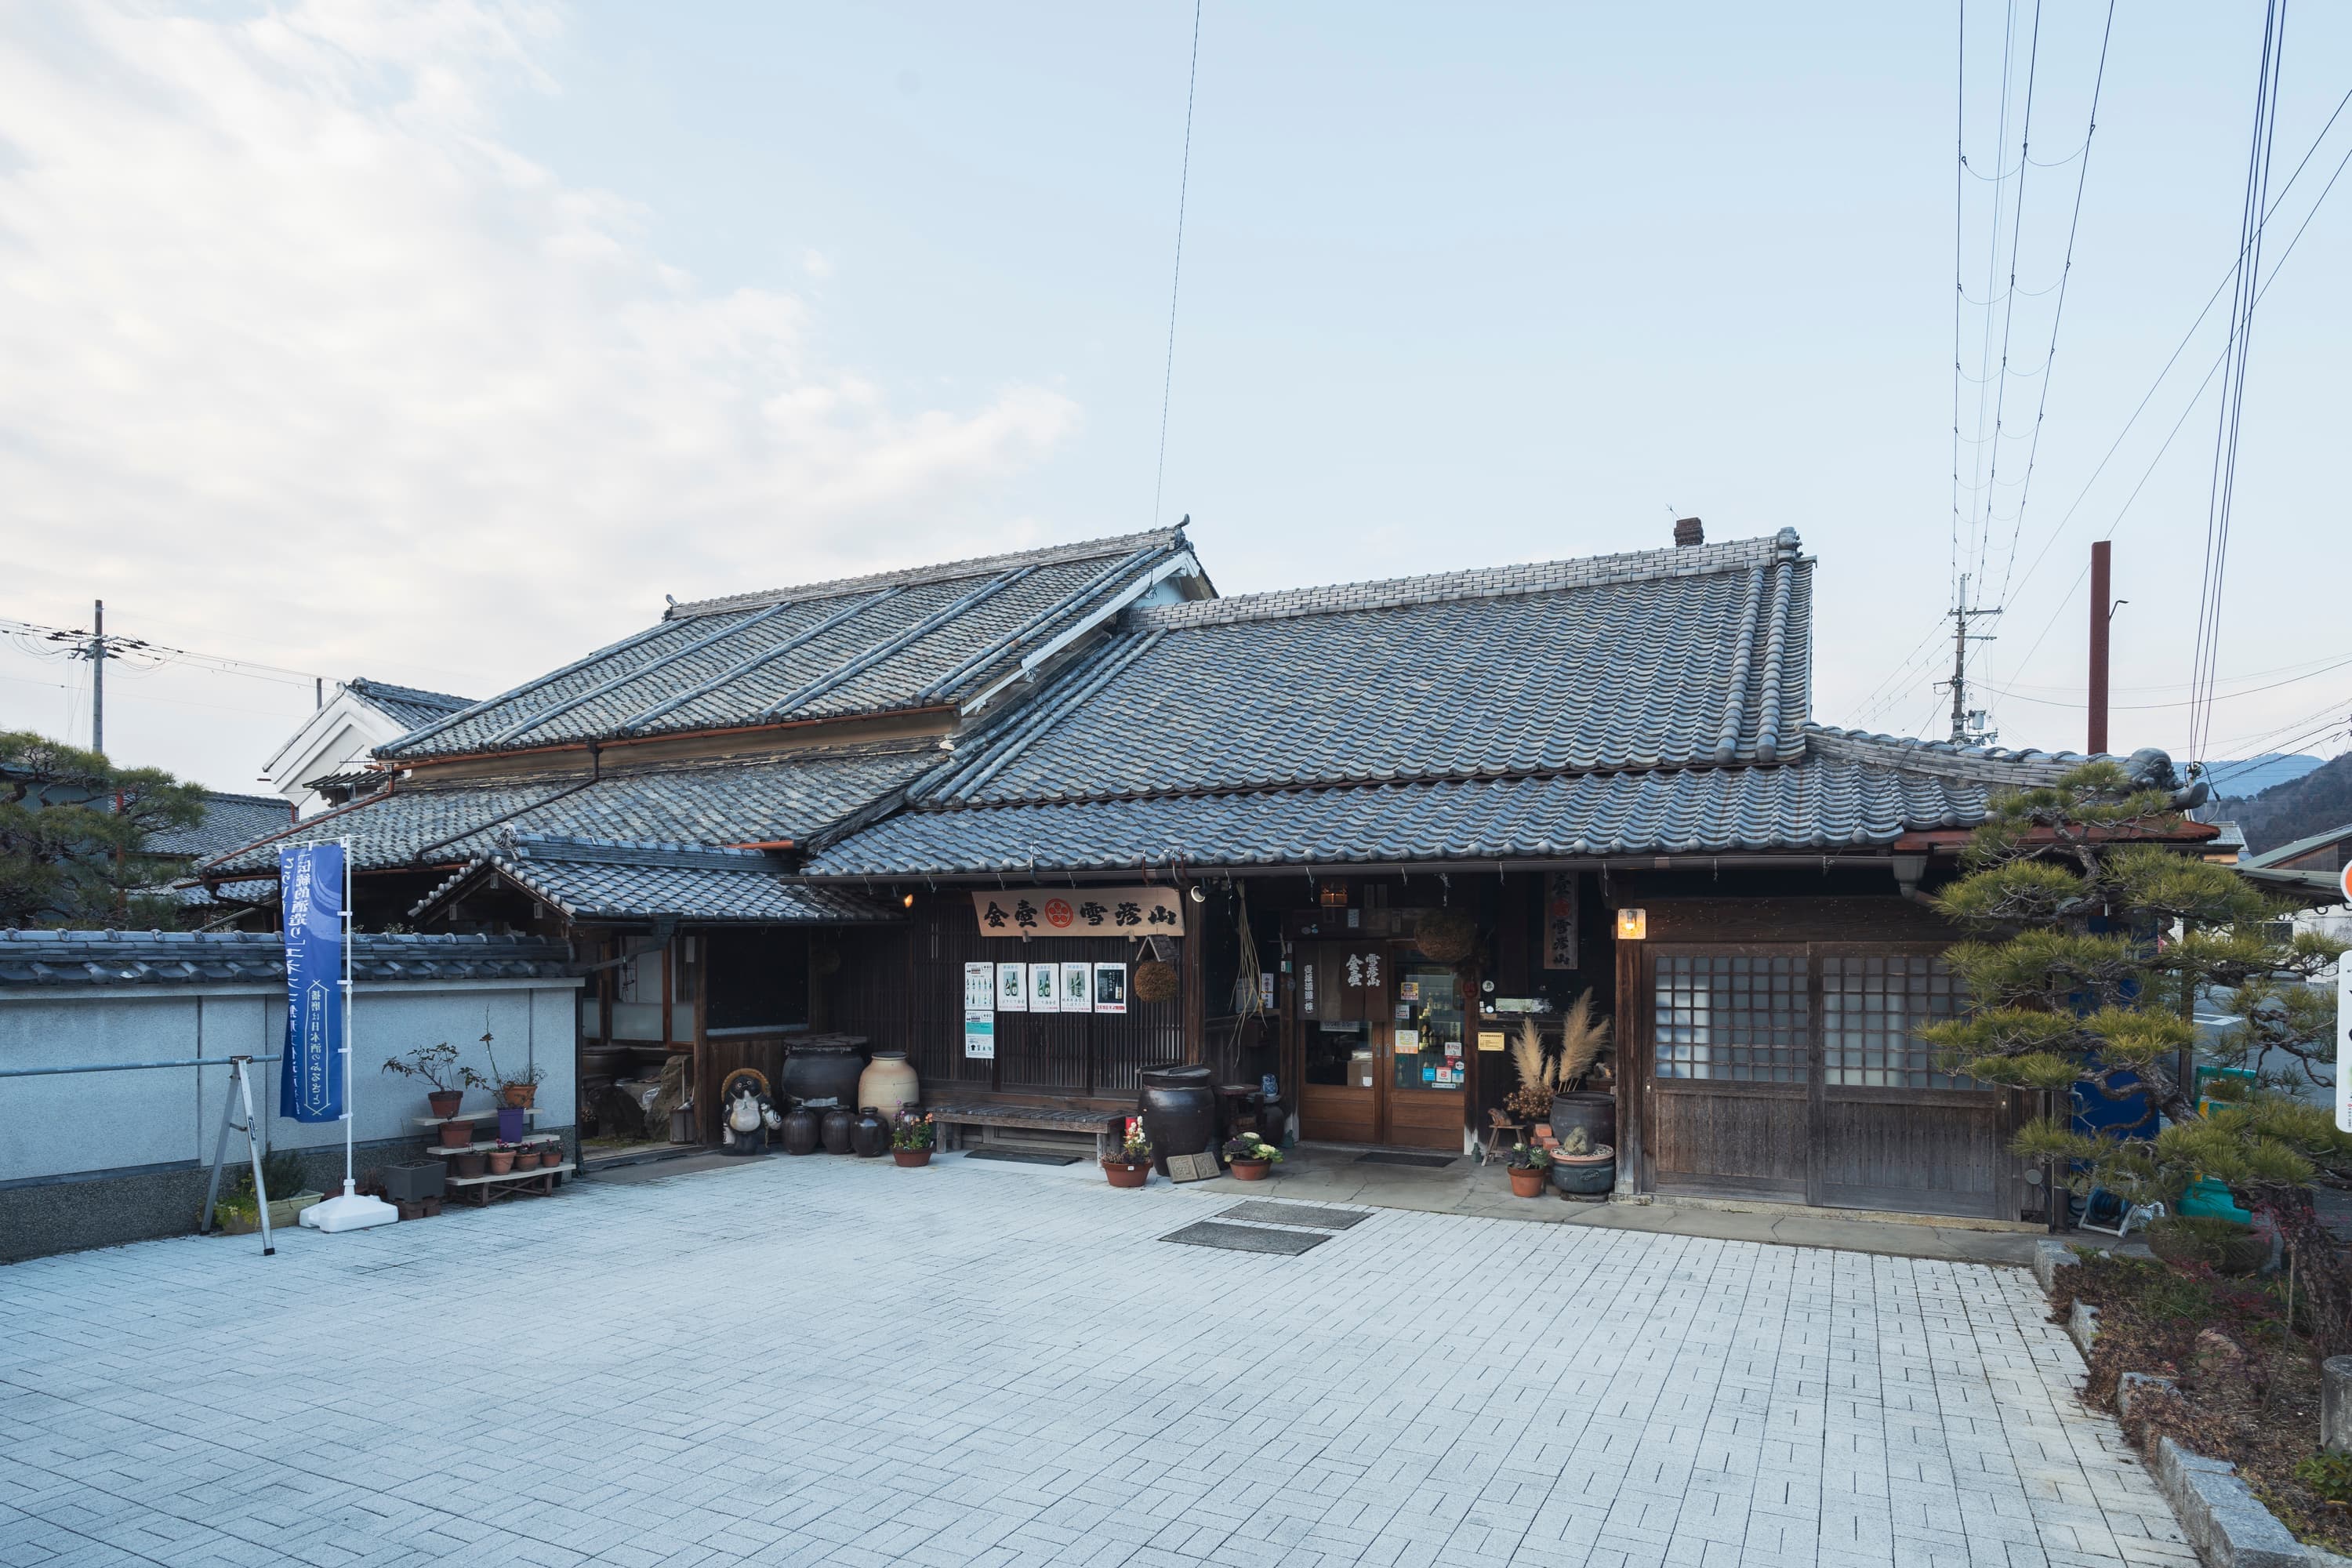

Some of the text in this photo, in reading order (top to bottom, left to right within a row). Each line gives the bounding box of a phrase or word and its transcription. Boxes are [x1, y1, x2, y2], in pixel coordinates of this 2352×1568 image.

[1080, 901, 1178, 926] 雪彦山
[1365, 953, 1381, 987] 雪彦山
